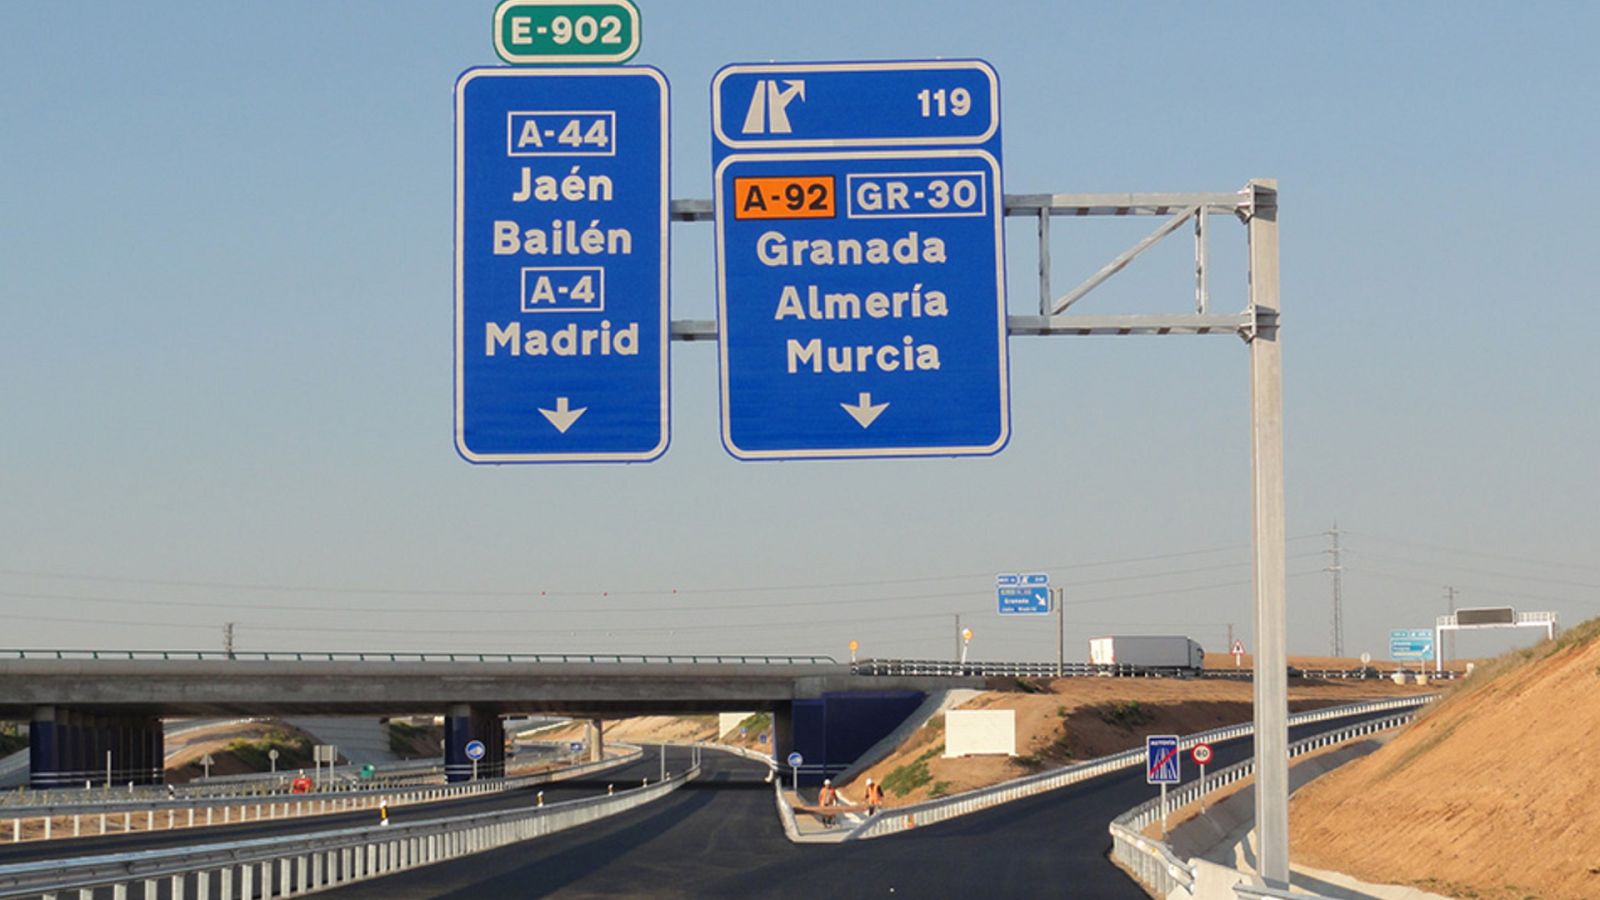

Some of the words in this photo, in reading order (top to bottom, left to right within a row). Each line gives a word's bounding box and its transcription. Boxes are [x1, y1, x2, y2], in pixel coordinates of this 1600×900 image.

[512, 16, 621, 44] E-902
[918, 88, 971, 117] 119
[517, 119, 608, 148] A-44
[512, 166, 613, 202] Jaén
[743, 184, 828, 212] A-92
[856, 180, 977, 211] GR-30
[493, 220, 632, 255] Bailén
[756, 231, 947, 266] Granada
[530, 275, 596, 304] A-4
[774, 283, 949, 320] Almería
[485, 320, 639, 356] Madrid
[786, 336, 941, 373] Murcia
